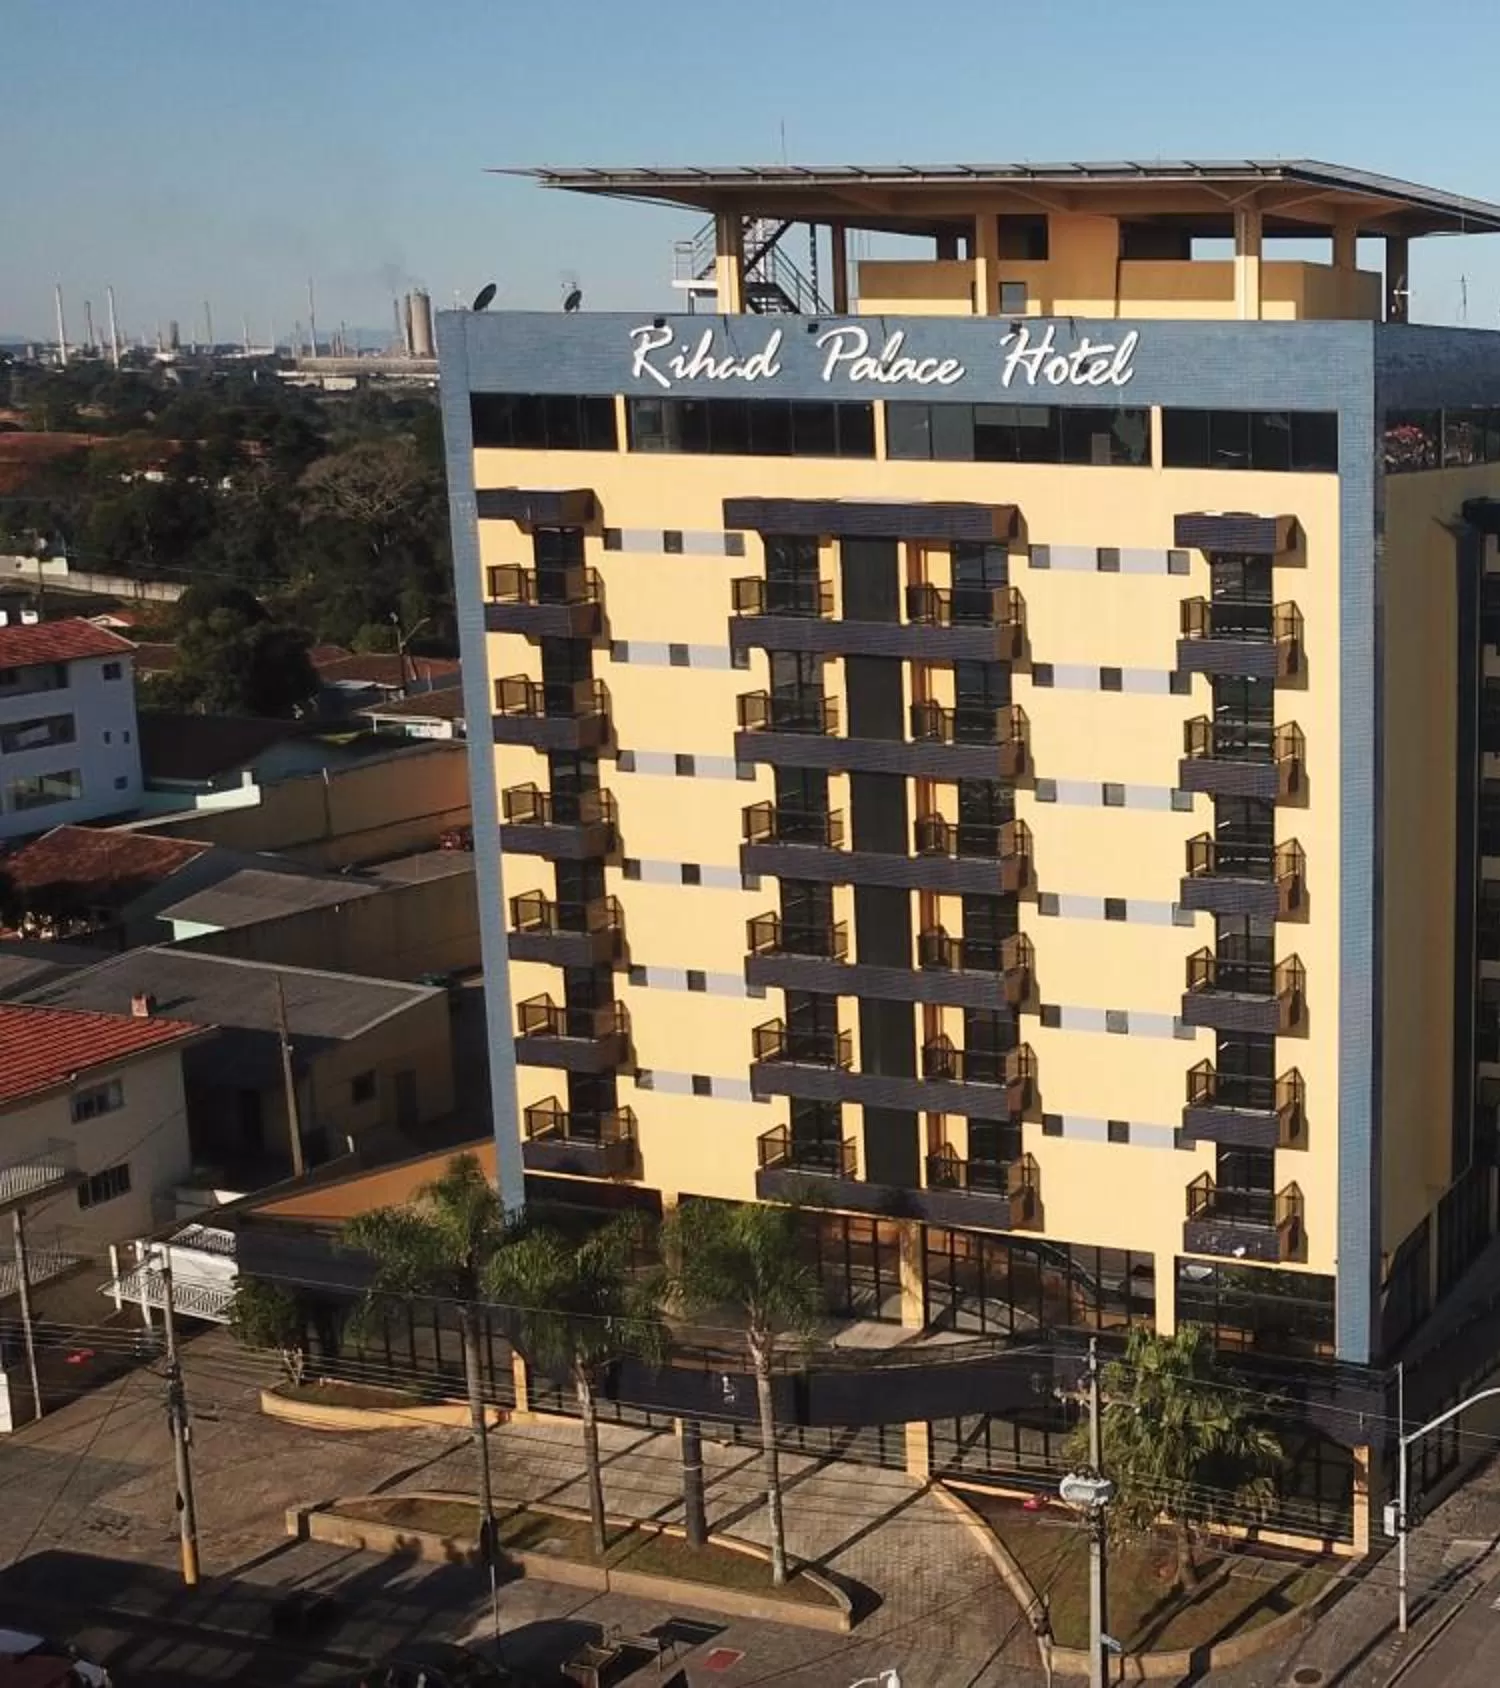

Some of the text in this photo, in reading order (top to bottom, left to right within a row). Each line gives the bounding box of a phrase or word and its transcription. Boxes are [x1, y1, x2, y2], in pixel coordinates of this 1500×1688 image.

[630, 324, 1138, 388] Rihad Palace Hotel
